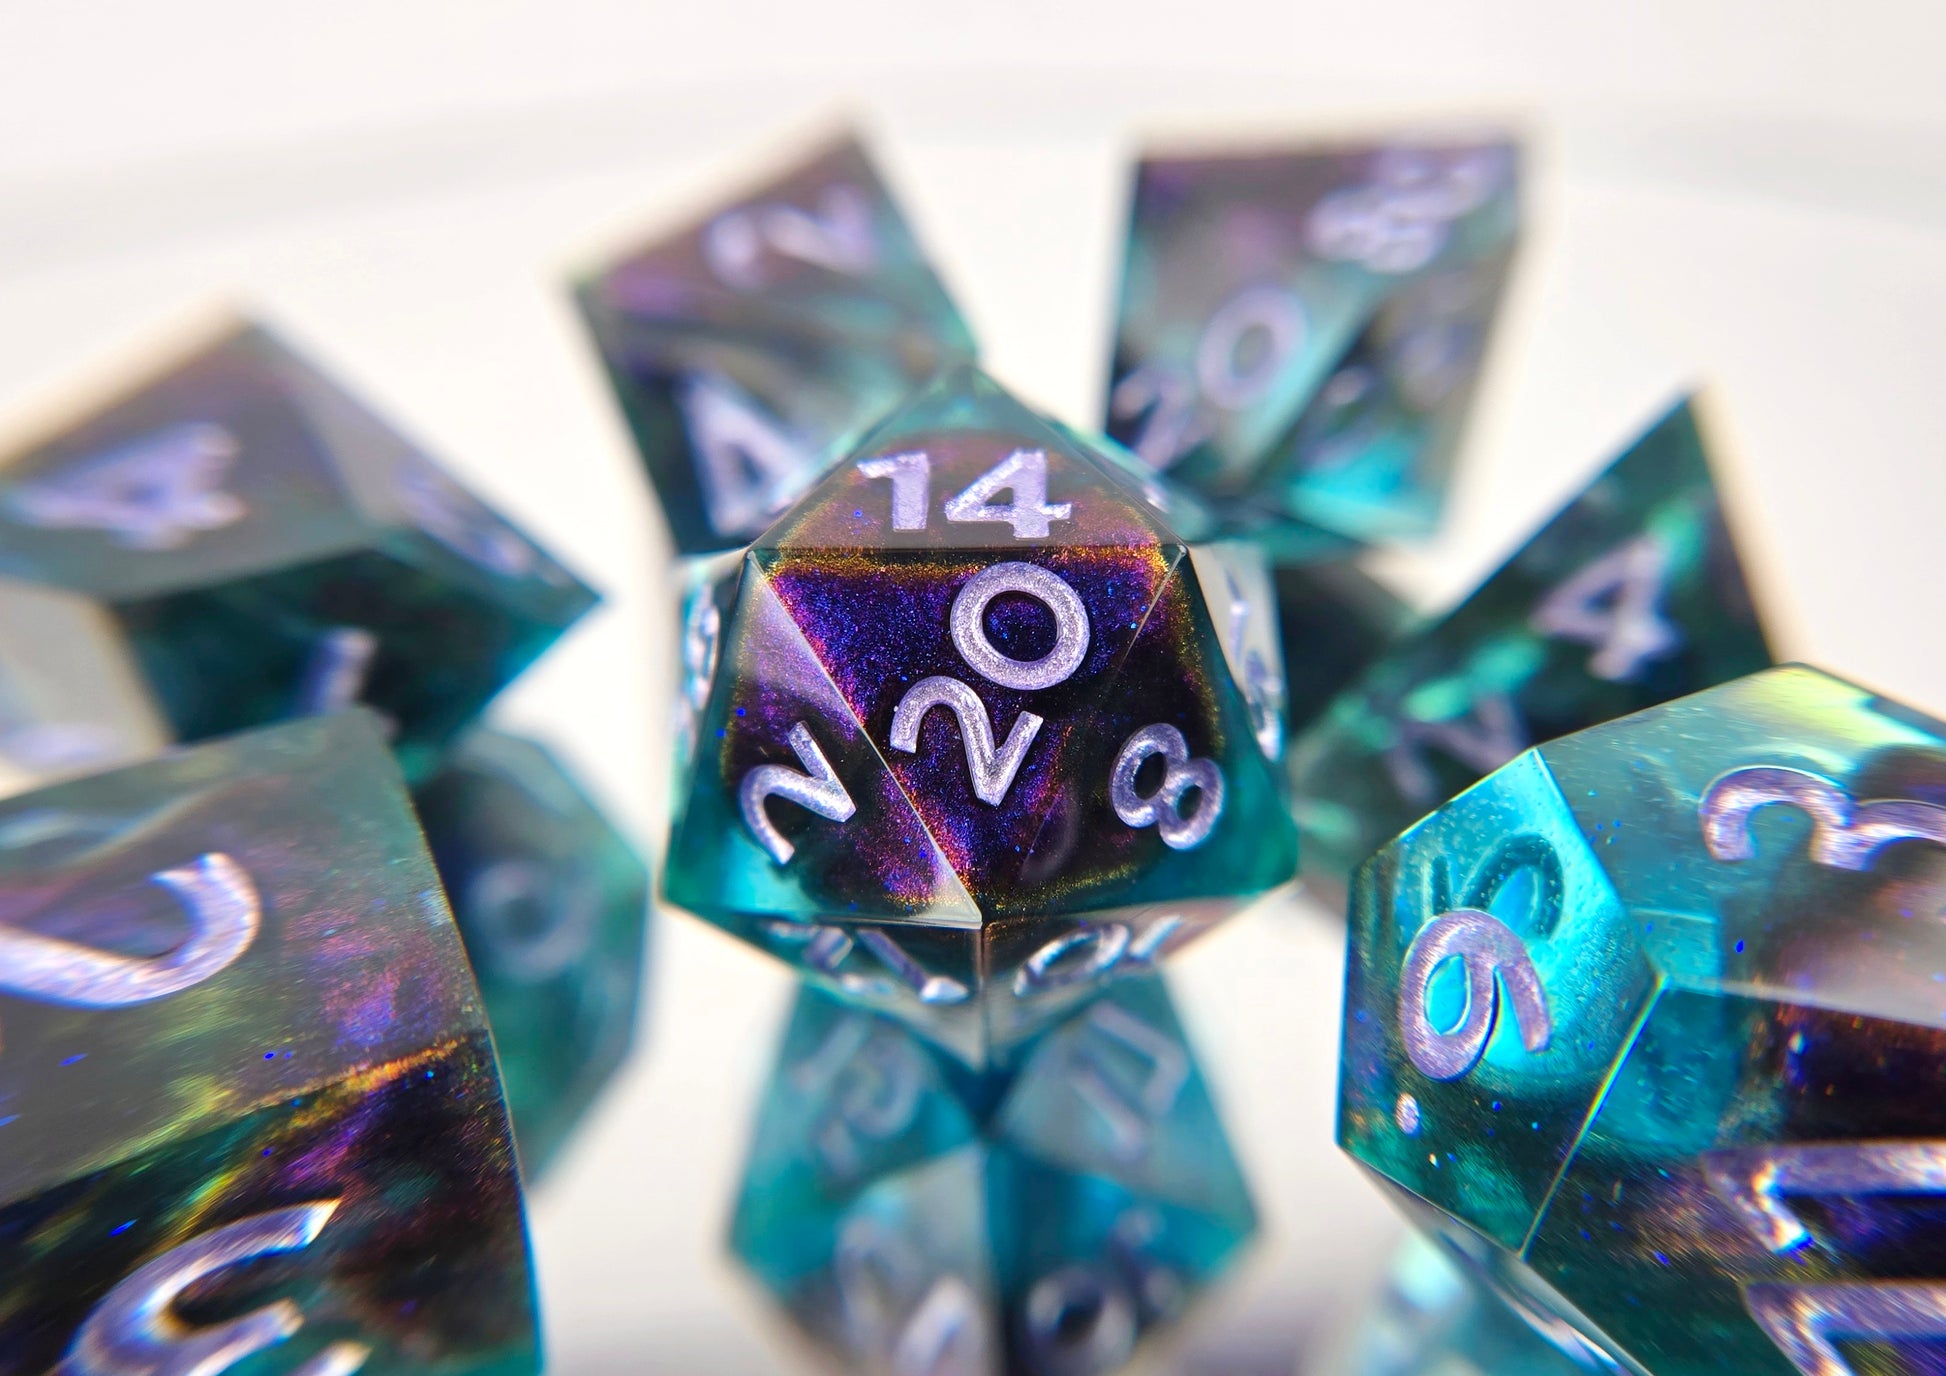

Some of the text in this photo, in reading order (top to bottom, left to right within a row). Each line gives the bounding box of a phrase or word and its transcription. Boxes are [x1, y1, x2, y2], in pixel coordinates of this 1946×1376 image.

[857, 449, 1072, 539] 14
[1527, 536, 1686, 680] 4
[890, 560, 1091, 806] 20
[739, 720, 857, 866] 2
[1110, 722, 1225, 850] 8
